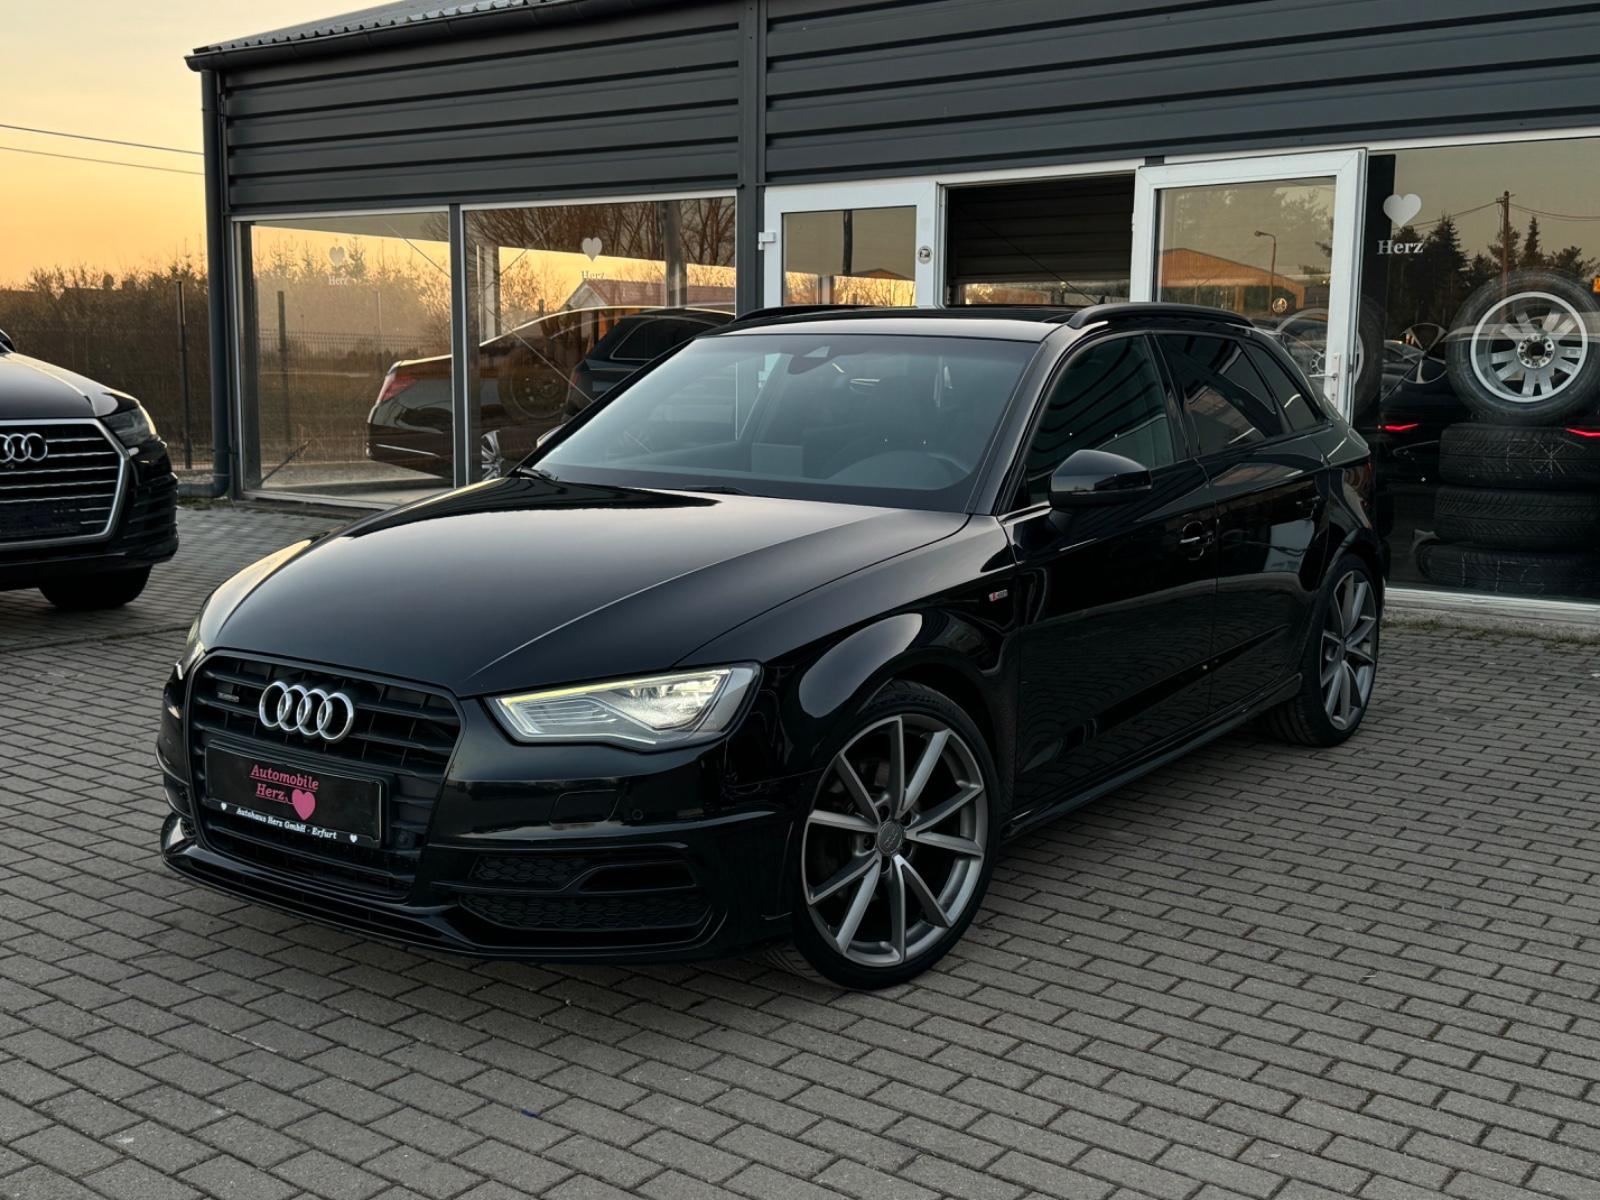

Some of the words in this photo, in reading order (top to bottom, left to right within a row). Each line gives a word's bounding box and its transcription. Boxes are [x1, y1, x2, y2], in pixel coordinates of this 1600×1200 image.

[1377, 240, 1424, 255] Herz
[251, 765, 319, 790] Automobile
[257, 783, 285, 799] Herz
[236, 808, 266, 821] Autohaus
[267, 816, 283, 827] Herz
[284, 820, 306, 832] GmbH
[312, 826, 337, 840] Erfurt
